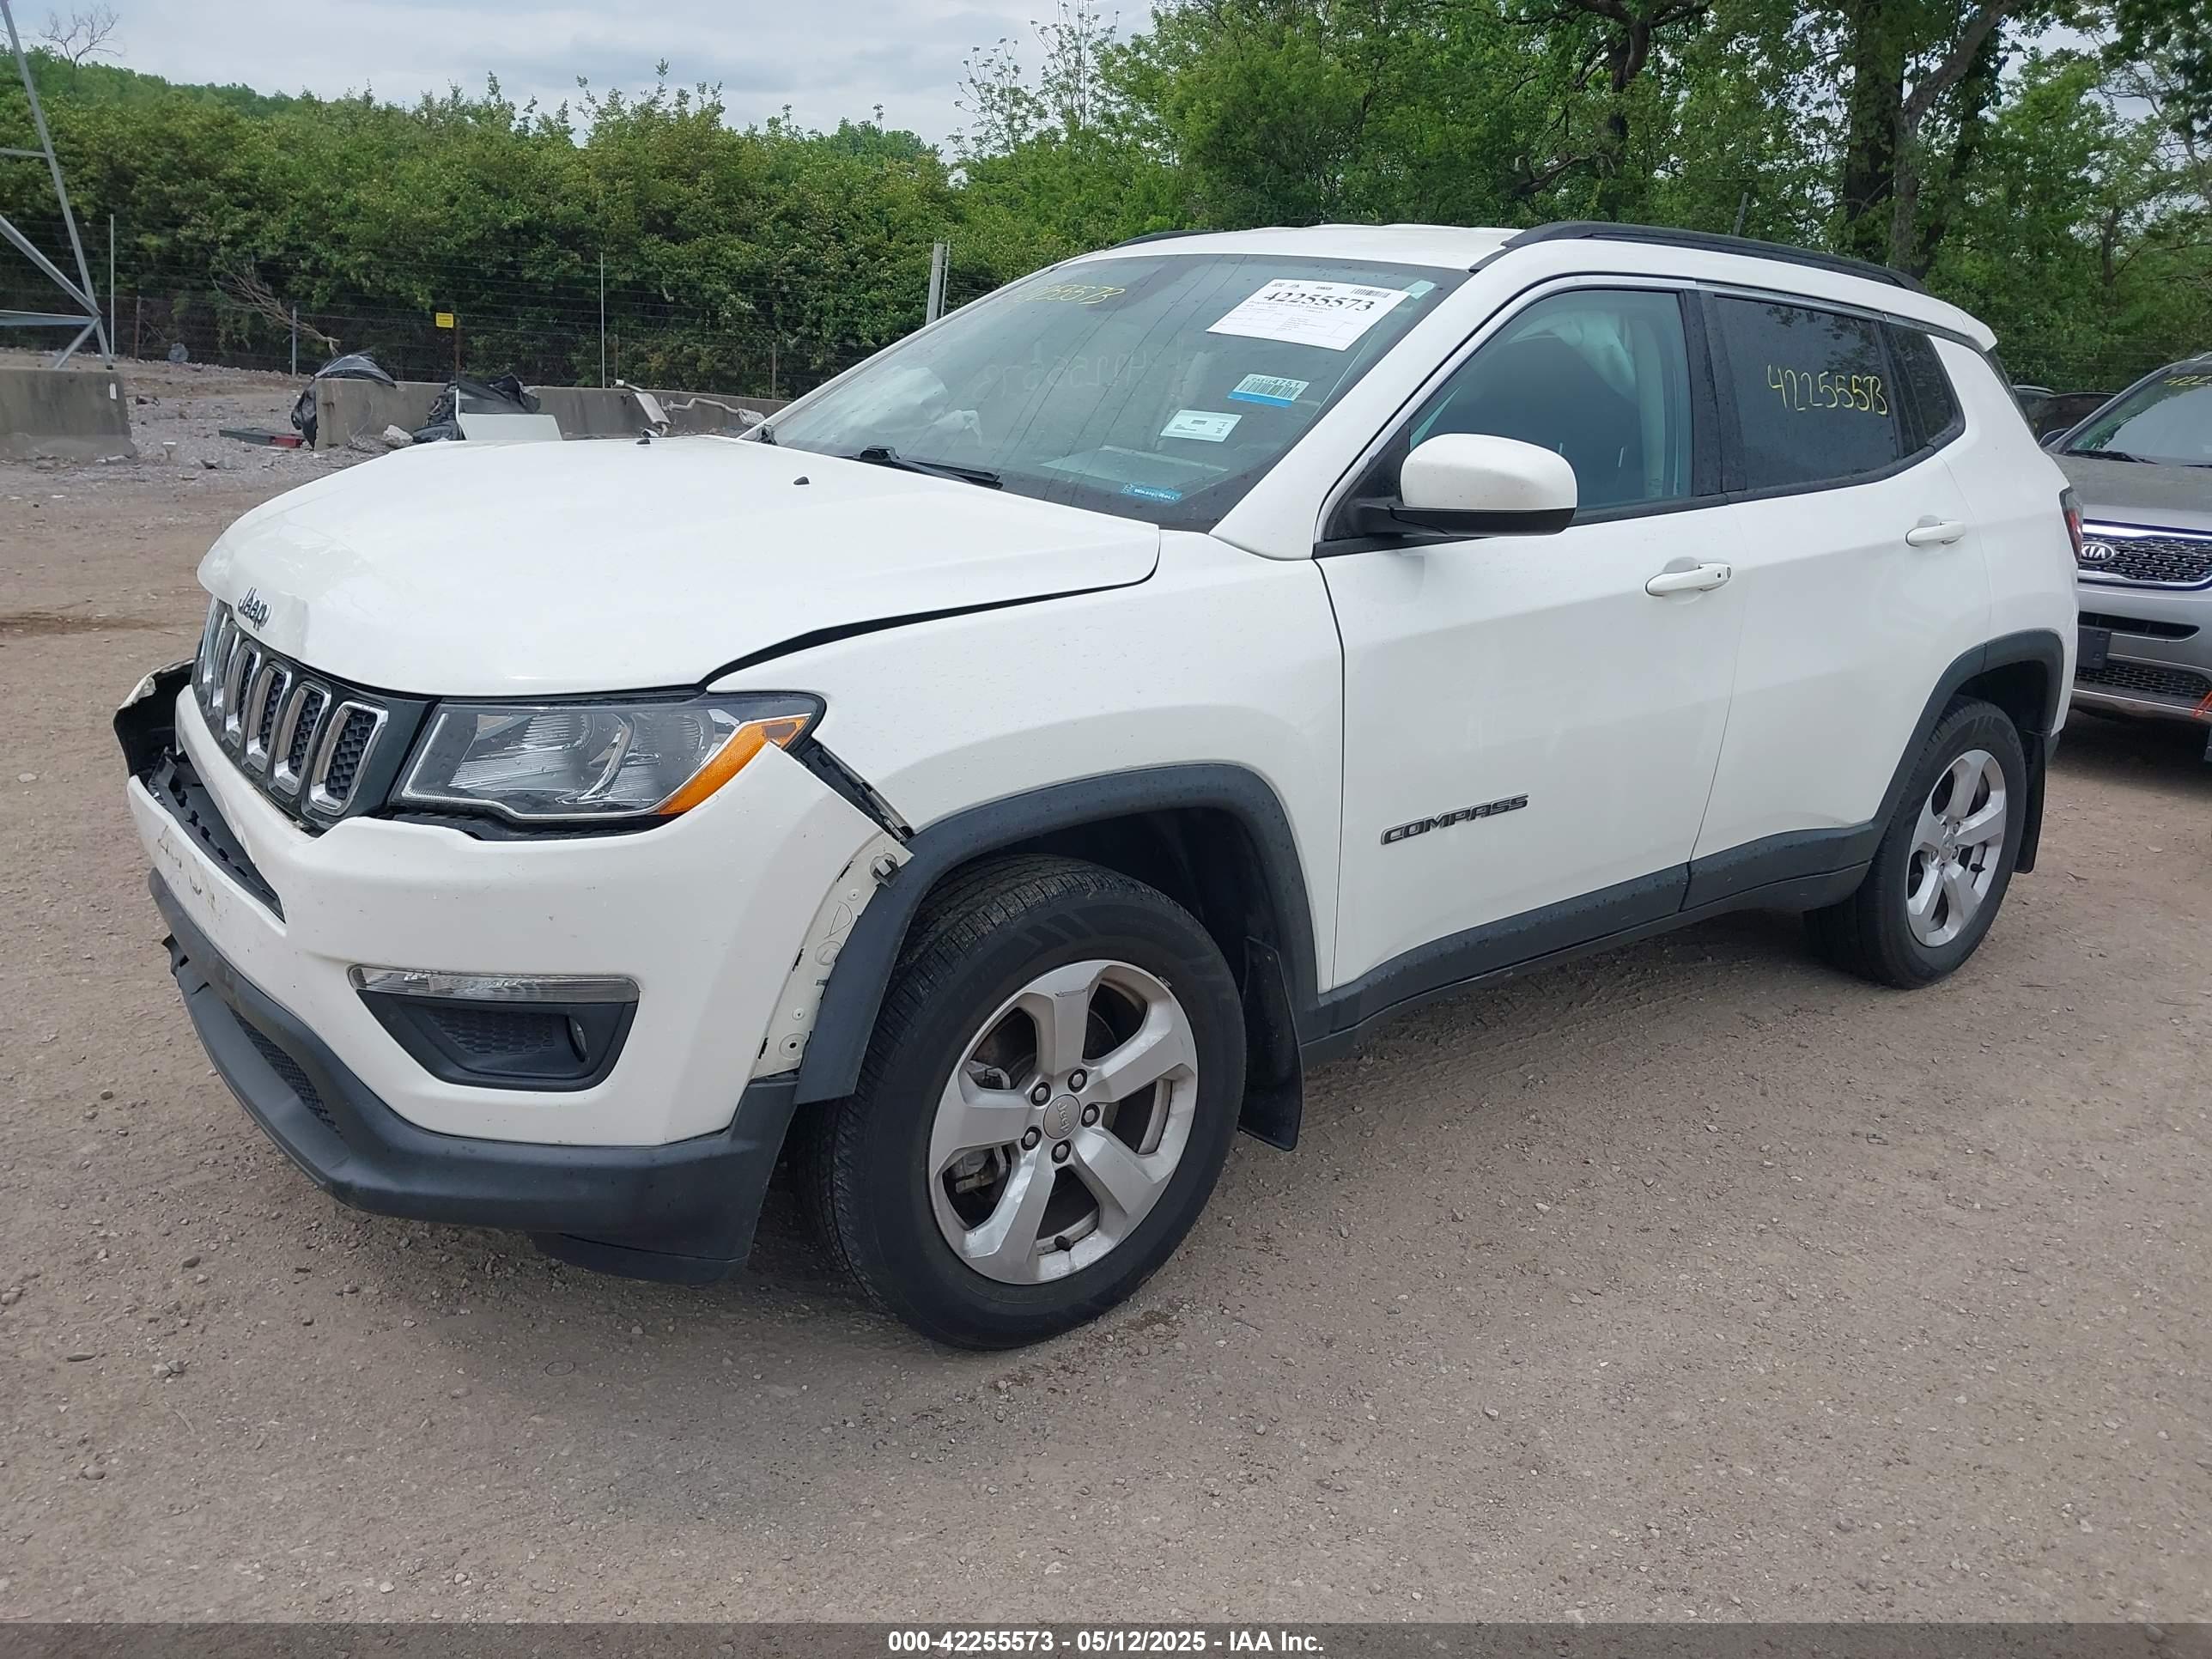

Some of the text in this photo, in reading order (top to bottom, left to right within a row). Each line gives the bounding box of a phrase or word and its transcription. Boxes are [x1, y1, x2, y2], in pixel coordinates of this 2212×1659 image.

[1264, 291, 1375, 312] 42255573
[1767, 364, 1888, 416] 42255573
[2081, 545, 2106, 559] KIA
[237, 586, 272, 633] Jeep
[1381, 793, 1529, 846] COMPASS
[1056, 1102, 1070, 1133] Jeep
